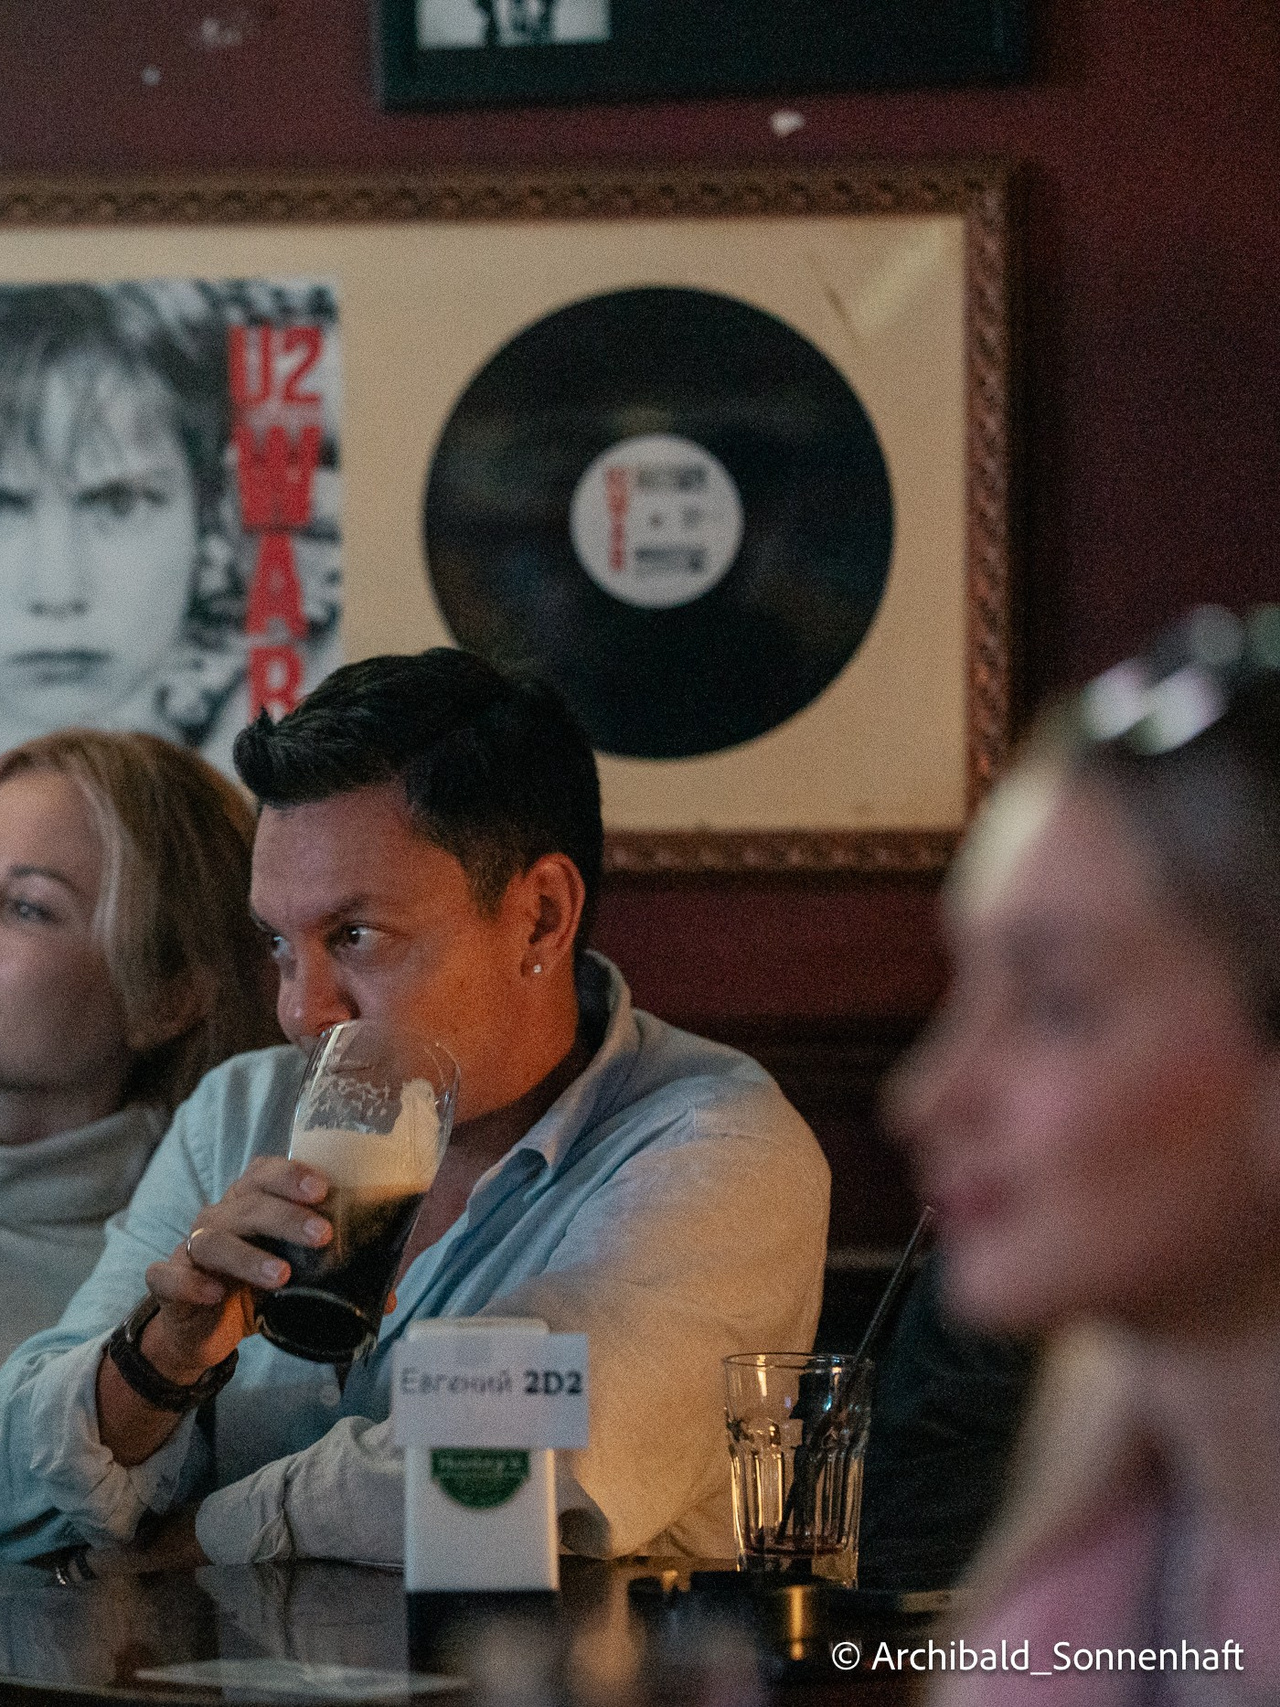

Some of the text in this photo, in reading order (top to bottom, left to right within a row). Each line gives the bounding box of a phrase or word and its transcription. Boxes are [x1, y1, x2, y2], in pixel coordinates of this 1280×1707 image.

[229, 324, 325, 405] U2
[230, 425, 325, 726] WAR
[400, 1365, 583, 1395] Евгений 2D2
